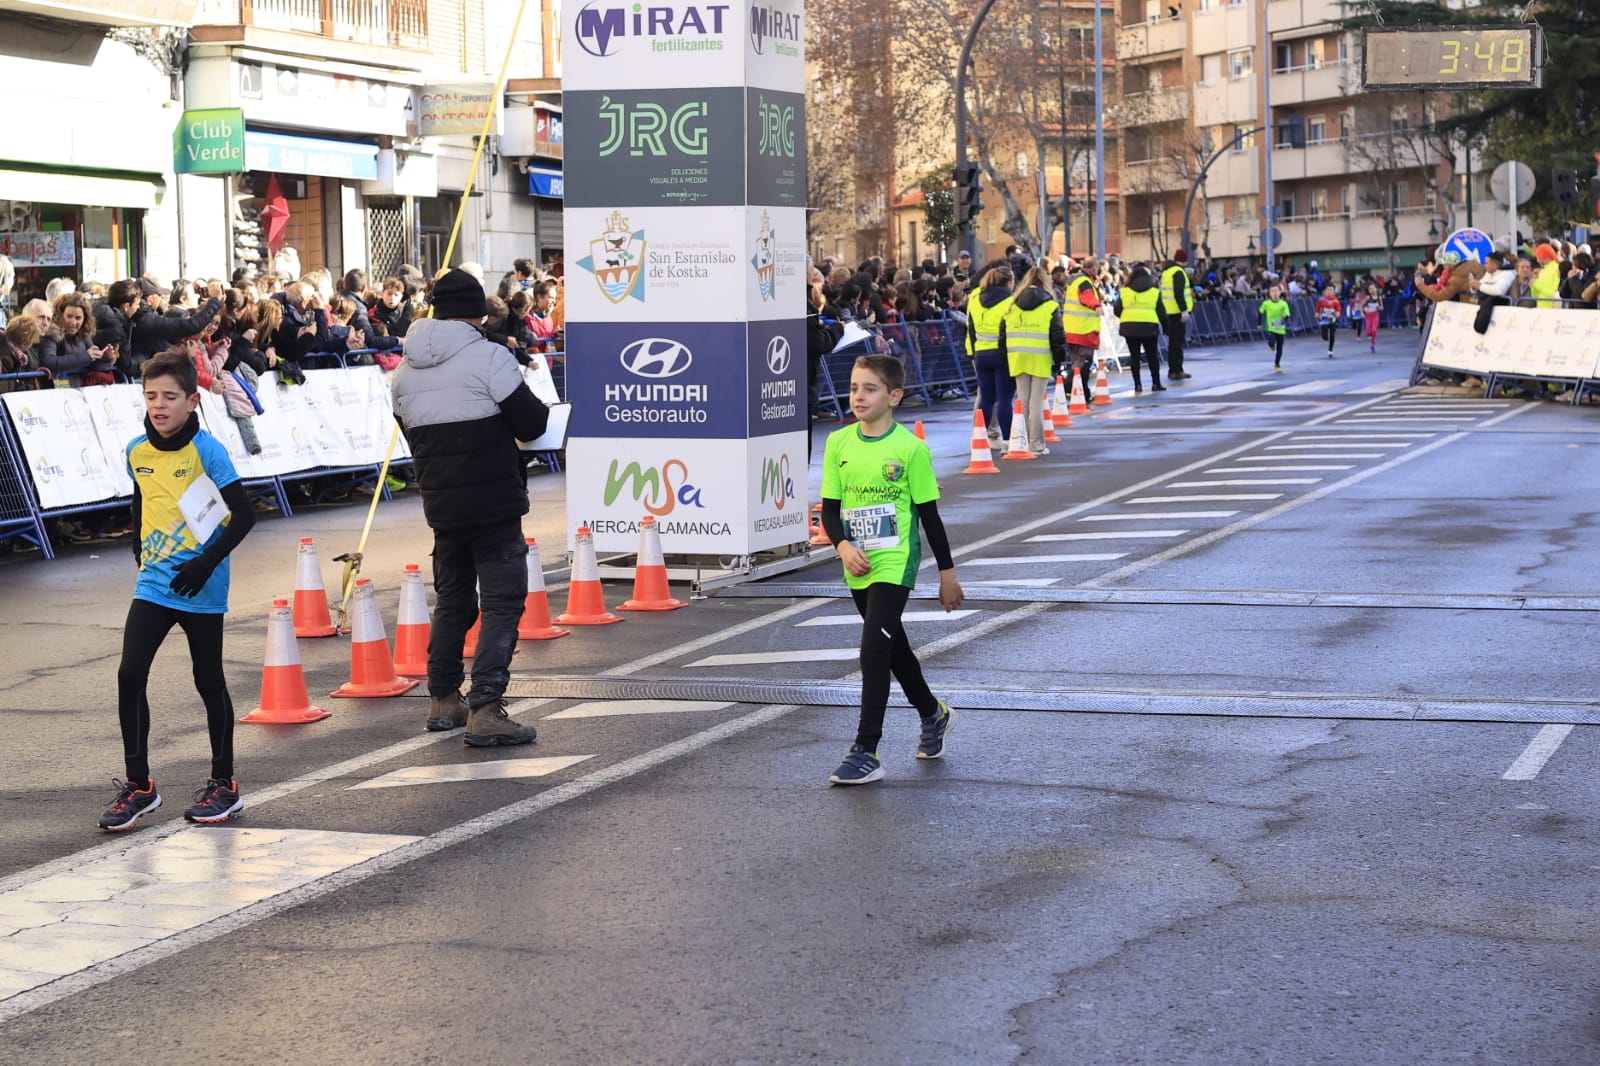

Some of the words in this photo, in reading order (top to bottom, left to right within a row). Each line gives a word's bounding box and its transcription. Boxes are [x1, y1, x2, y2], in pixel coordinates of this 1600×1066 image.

[651, 37, 723, 53] fertilizantes
[190, 120, 232, 140] Club
[187, 143, 240, 161] Verde
[649, 251, 671, 264] San
[674, 251, 736, 264] Estanislao
[649, 265, 664, 278] de
[667, 265, 708, 278] Kostka
[605, 384, 708, 402] HYUNDAI
[761, 380, 796, 399] HYUNDAI
[605, 405, 707, 423] Gestorauto
[761, 402, 796, 420] Gestorauto
[853, 507, 890, 518] SETEL
[754, 512, 804, 532] MERCASALAMANCA
[849, 517, 882, 537] 5967
